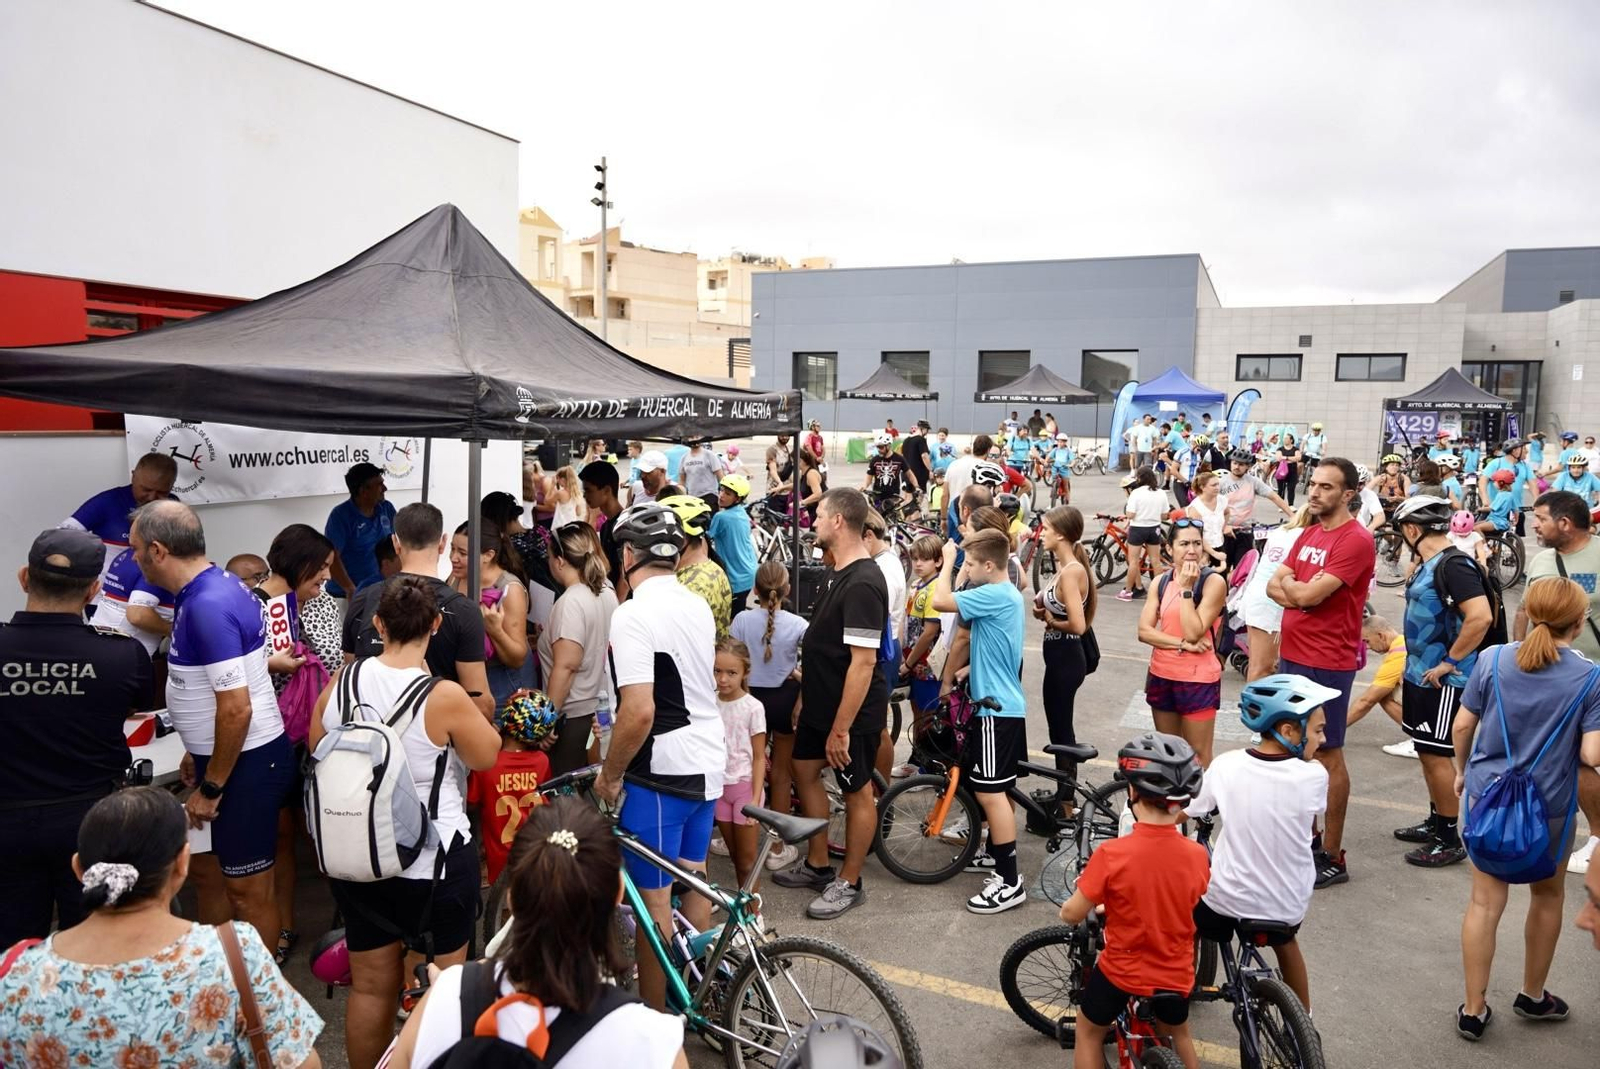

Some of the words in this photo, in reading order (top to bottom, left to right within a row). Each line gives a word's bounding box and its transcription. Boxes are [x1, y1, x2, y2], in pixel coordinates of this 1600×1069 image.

[551, 399, 602, 418] AYTO.
[605, 399, 629, 418] DE
[707, 398, 724, 418] DE
[730, 398, 772, 420] ALMERÍA
[1398, 414, 1436, 433] 429
[198, 429, 207, 439] DE
[228, 444, 371, 469] www.cchuercal.es
[270, 602, 290, 651] 083
[2, 662, 97, 678] OLICIA
[495, 772, 538, 793] JESUS
[324, 808, 363, 817] Quechua
